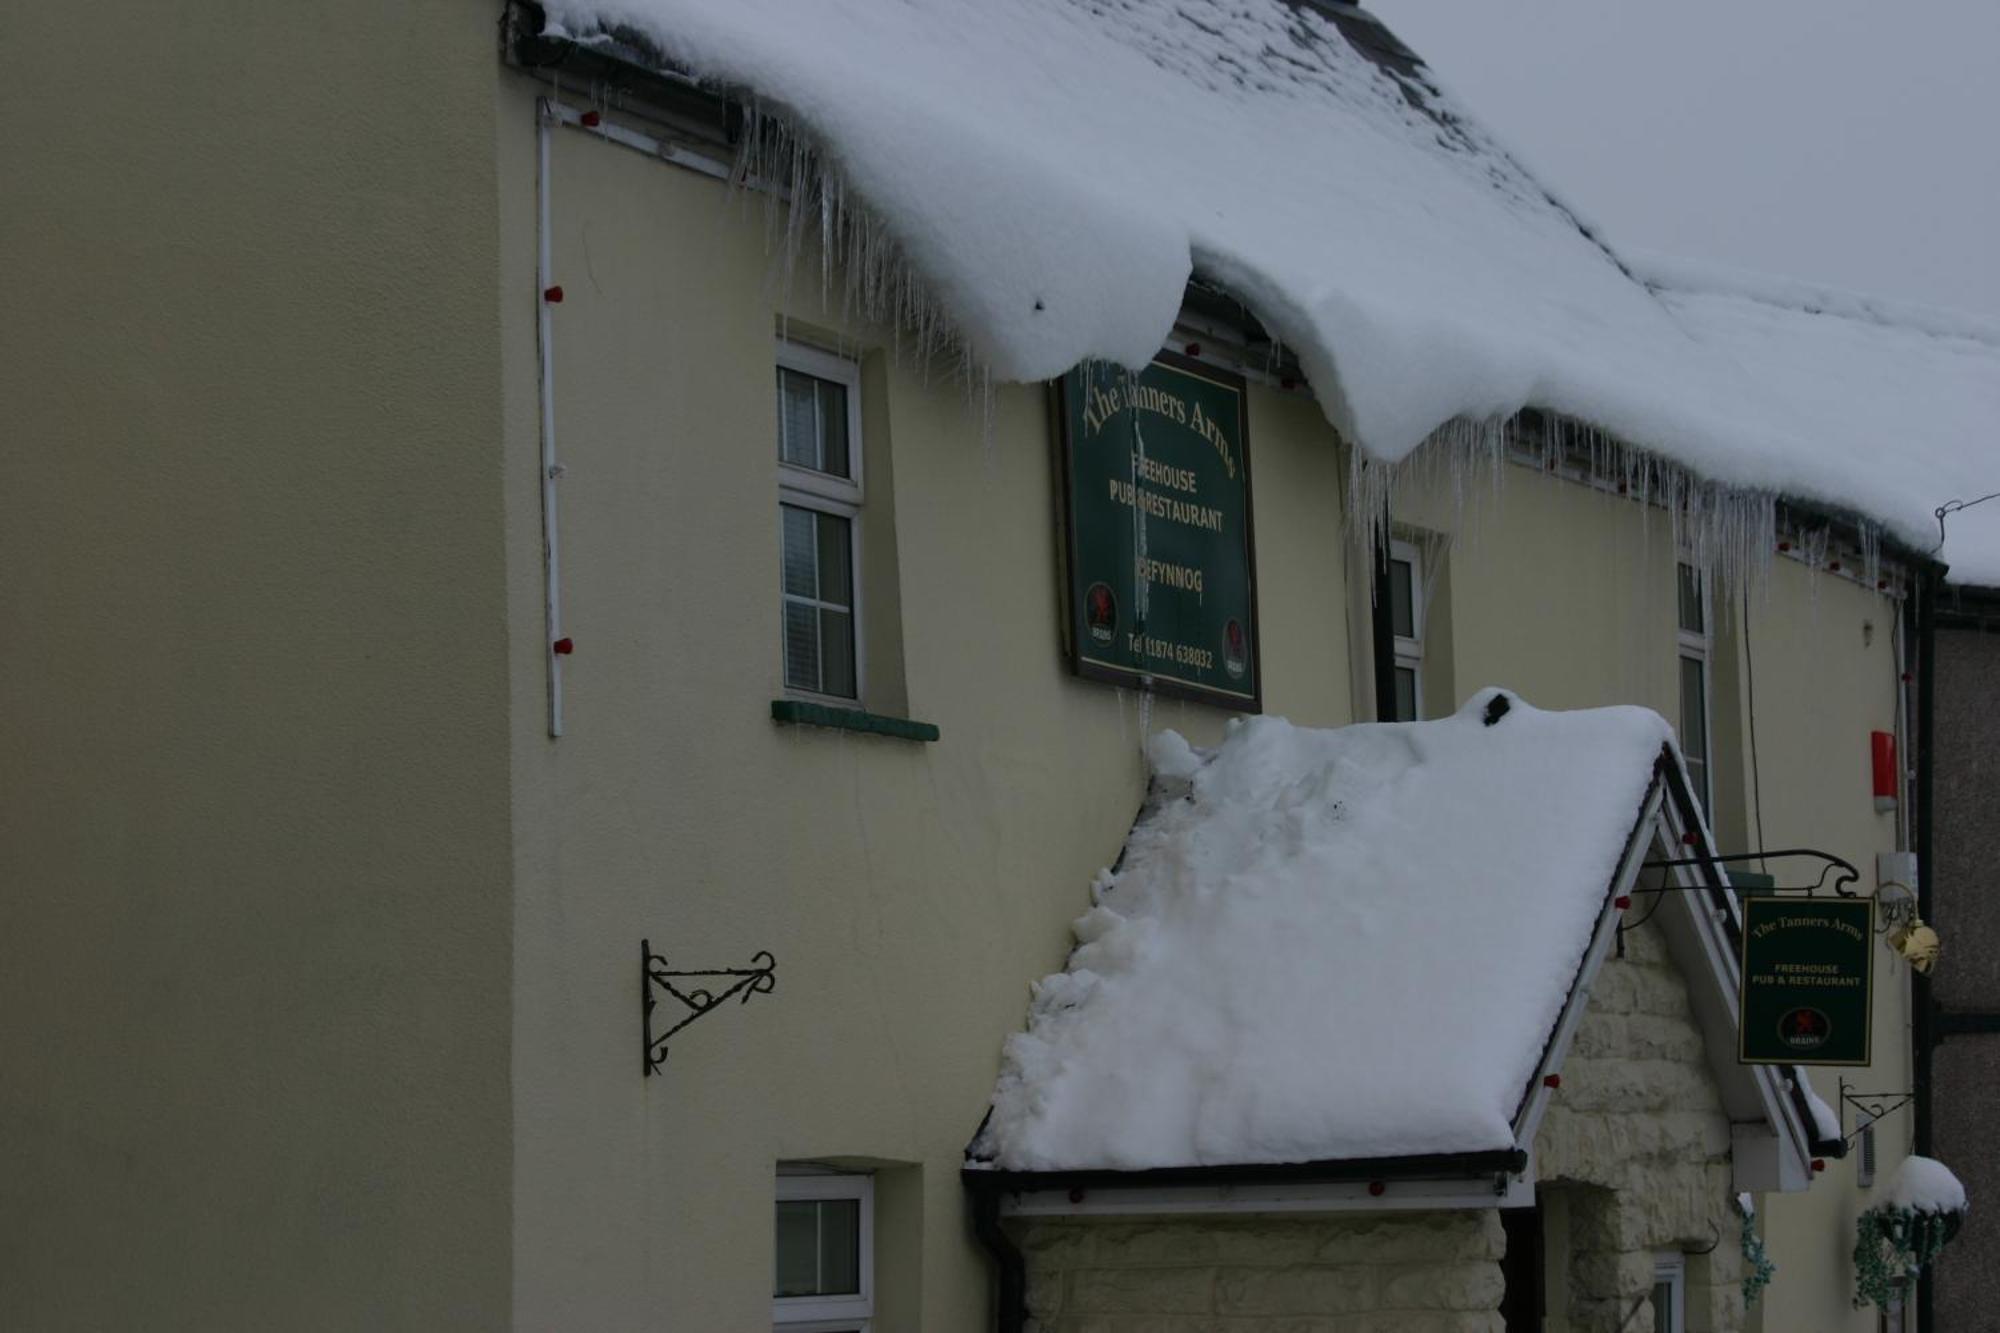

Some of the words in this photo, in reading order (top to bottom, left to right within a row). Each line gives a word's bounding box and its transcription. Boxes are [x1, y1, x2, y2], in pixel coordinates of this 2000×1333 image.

[1083, 384, 1121, 434] The
[1190, 401, 1236, 479] Arms
[1109, 479, 1135, 506] PUB
[1146, 491, 1223, 532] RESTAURANT
[1753, 922, 1777, 940] The
[1777, 915, 1830, 930] Tanners
[1831, 916, 1863, 941] Arms
[1752, 974, 1775, 985] PUB
[1777, 976, 1786, 986] &
[1788, 975, 1861, 988] RESTAURANT
[1774, 963, 1840, 975] FREEHOUSE
